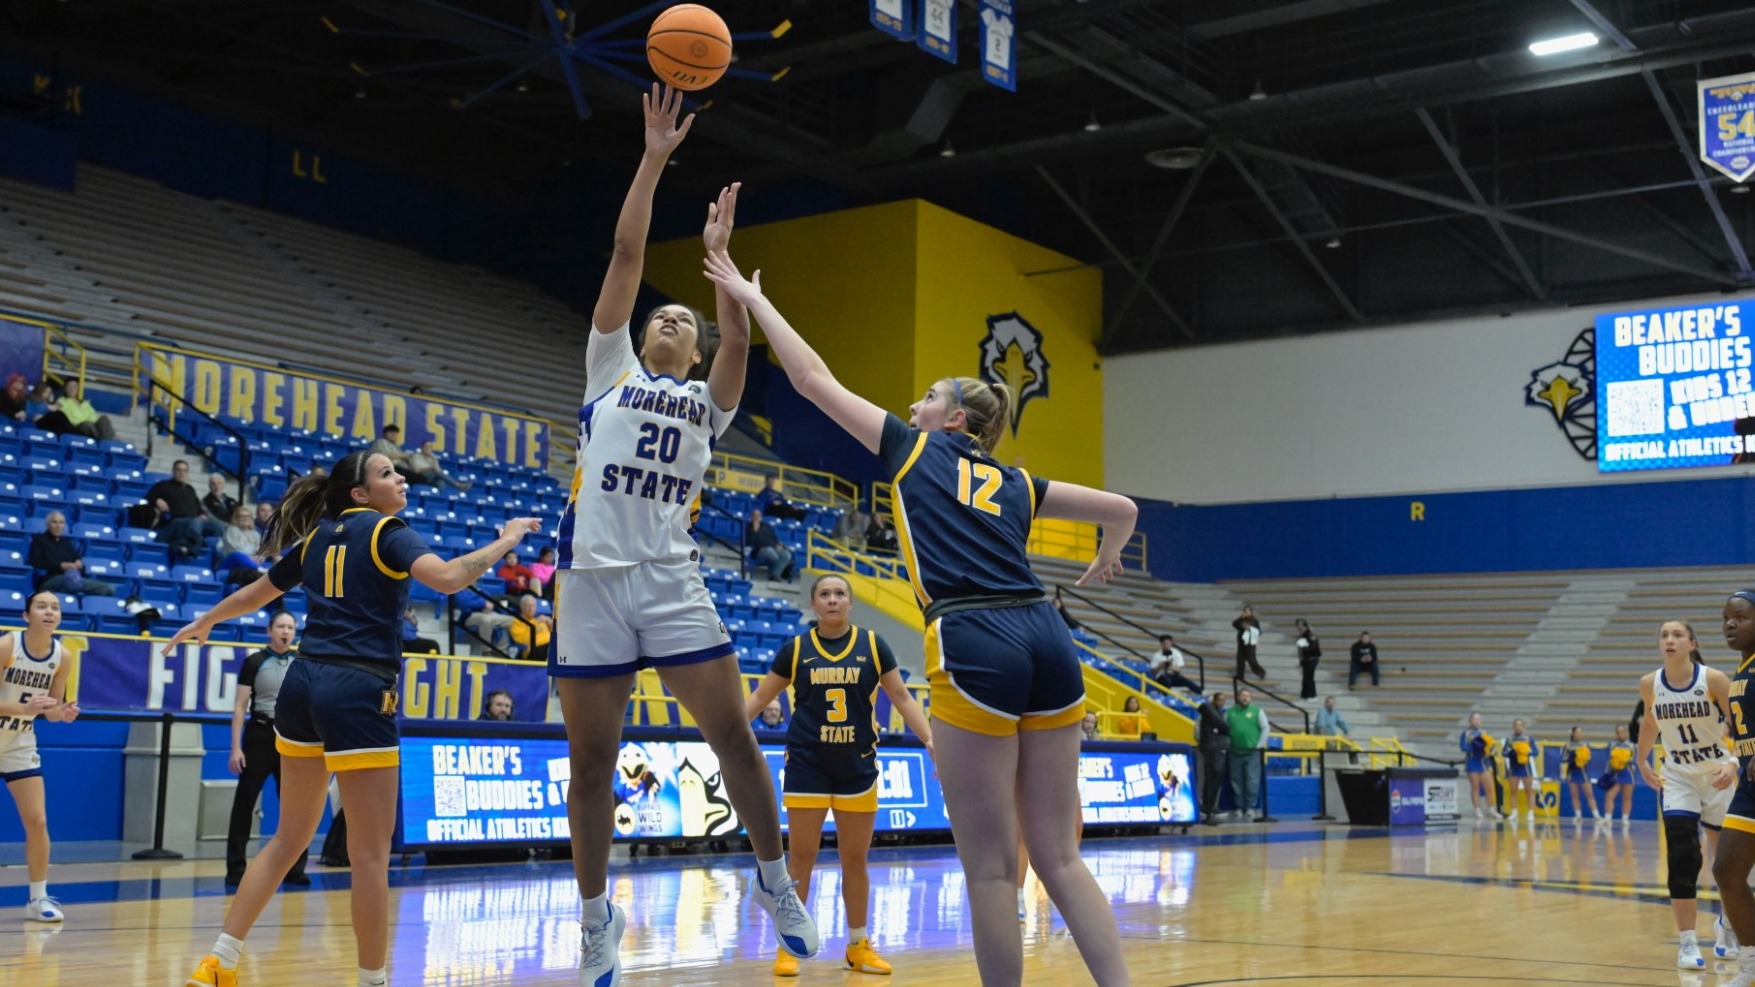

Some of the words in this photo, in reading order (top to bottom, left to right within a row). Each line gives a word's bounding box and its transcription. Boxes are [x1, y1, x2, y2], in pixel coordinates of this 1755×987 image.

[1718, 110, 1755, 141] 54
[1614, 305, 1741, 348] BEAKER'S
[1638, 336, 1752, 377] BUDDIES
[1670, 373, 1723, 405] KIDS
[1725, 367, 1752, 395] 12
[152, 351, 406, 447] MOREHEAD
[425, 402, 541, 468] STATE
[617, 385, 706, 427] MOREHEAD
[635, 422, 682, 464] 20
[1605, 440, 1667, 462] OFFICIAL
[1668, 435, 1744, 459] ATHLETICS
[601, 463, 693, 506] STATE
[957, 456, 1003, 517] 12
[1411, 501, 1425, 521] R
[324, 544, 347, 598] 11
[5, 667, 51, 690] MOREHEA
[147, 642, 250, 712] FIG
[402, 658, 488, 720] GHT
[810, 667, 861, 685] MURRAY
[825, 688, 848, 723] 3
[1655, 701, 1710, 720] MOREHEAD
[0, 715, 32, 732] TAT
[820, 725, 855, 743] STATE
[1677, 723, 1699, 744] 11
[432, 745, 522, 775] BEAKER'S
[1670, 743, 1724, 765] STATE
[466, 780, 544, 811] BUDDIES
[427, 818, 485, 841] OFFICIAL
[487, 817, 552, 840] ATHLETICS
[638, 812, 662, 823] WILD
